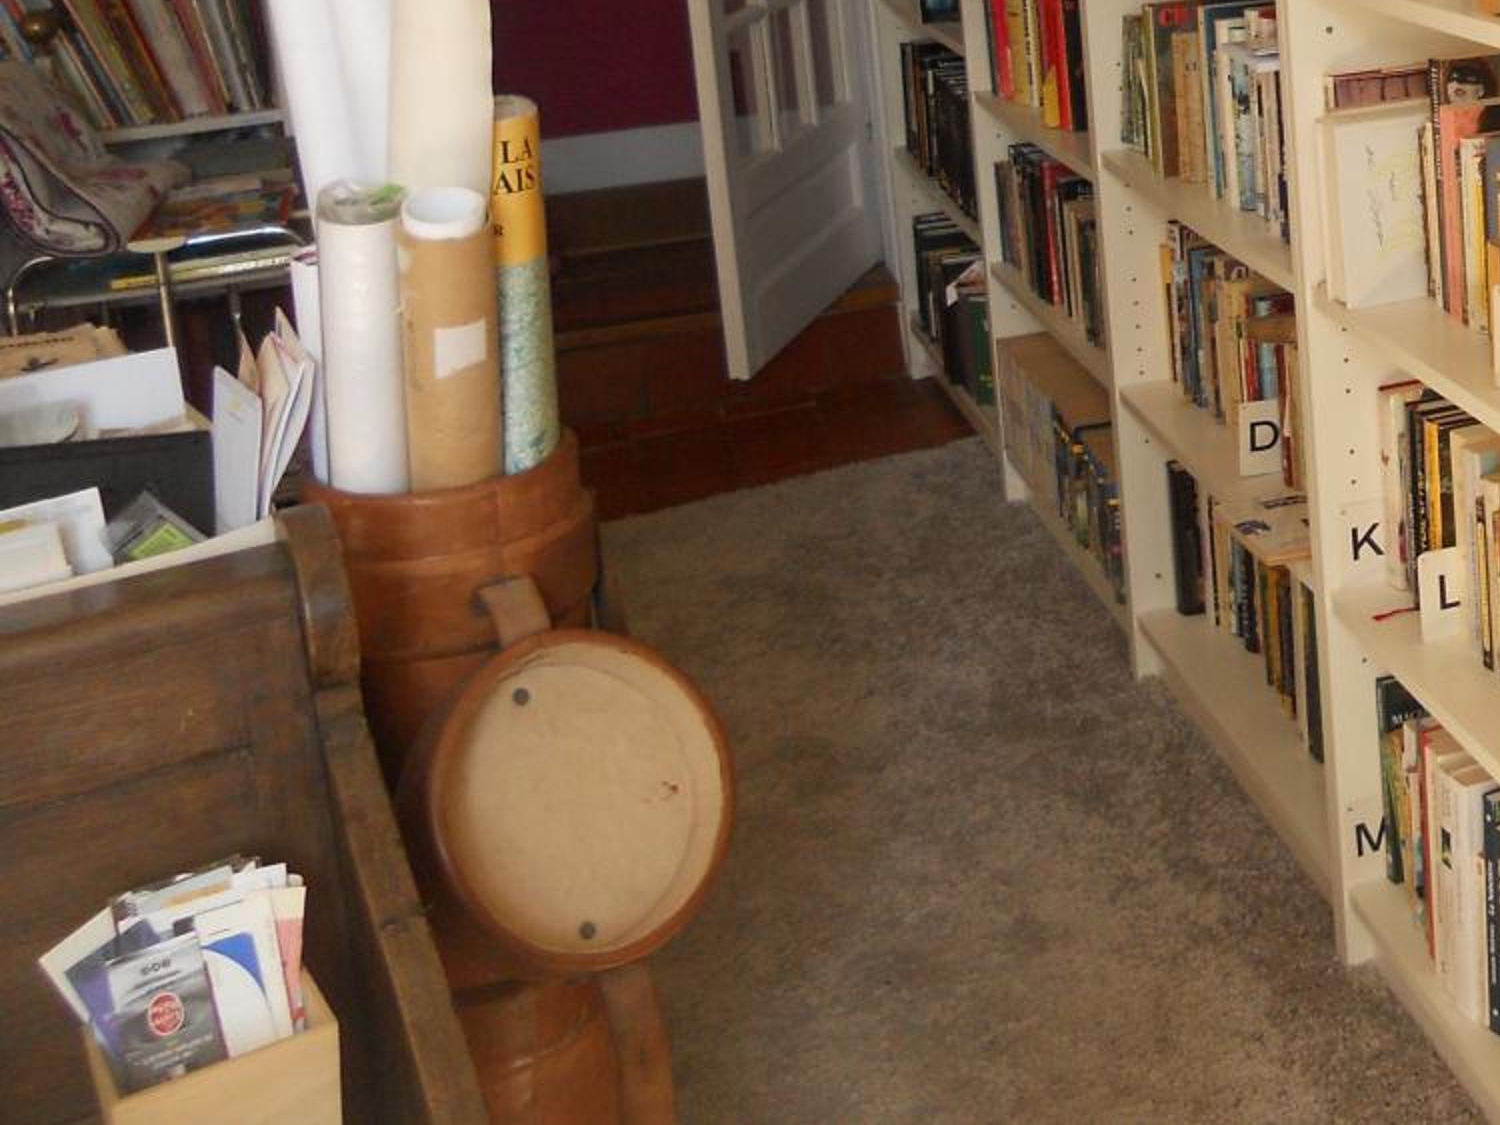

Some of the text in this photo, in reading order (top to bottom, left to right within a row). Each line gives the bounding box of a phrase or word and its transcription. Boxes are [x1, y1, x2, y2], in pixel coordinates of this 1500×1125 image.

[1249, 419, 1280, 453] D
[1351, 522, 1384, 561] K
[1439, 574, 1461, 610] L
[1354, 817, 1387, 858] M
